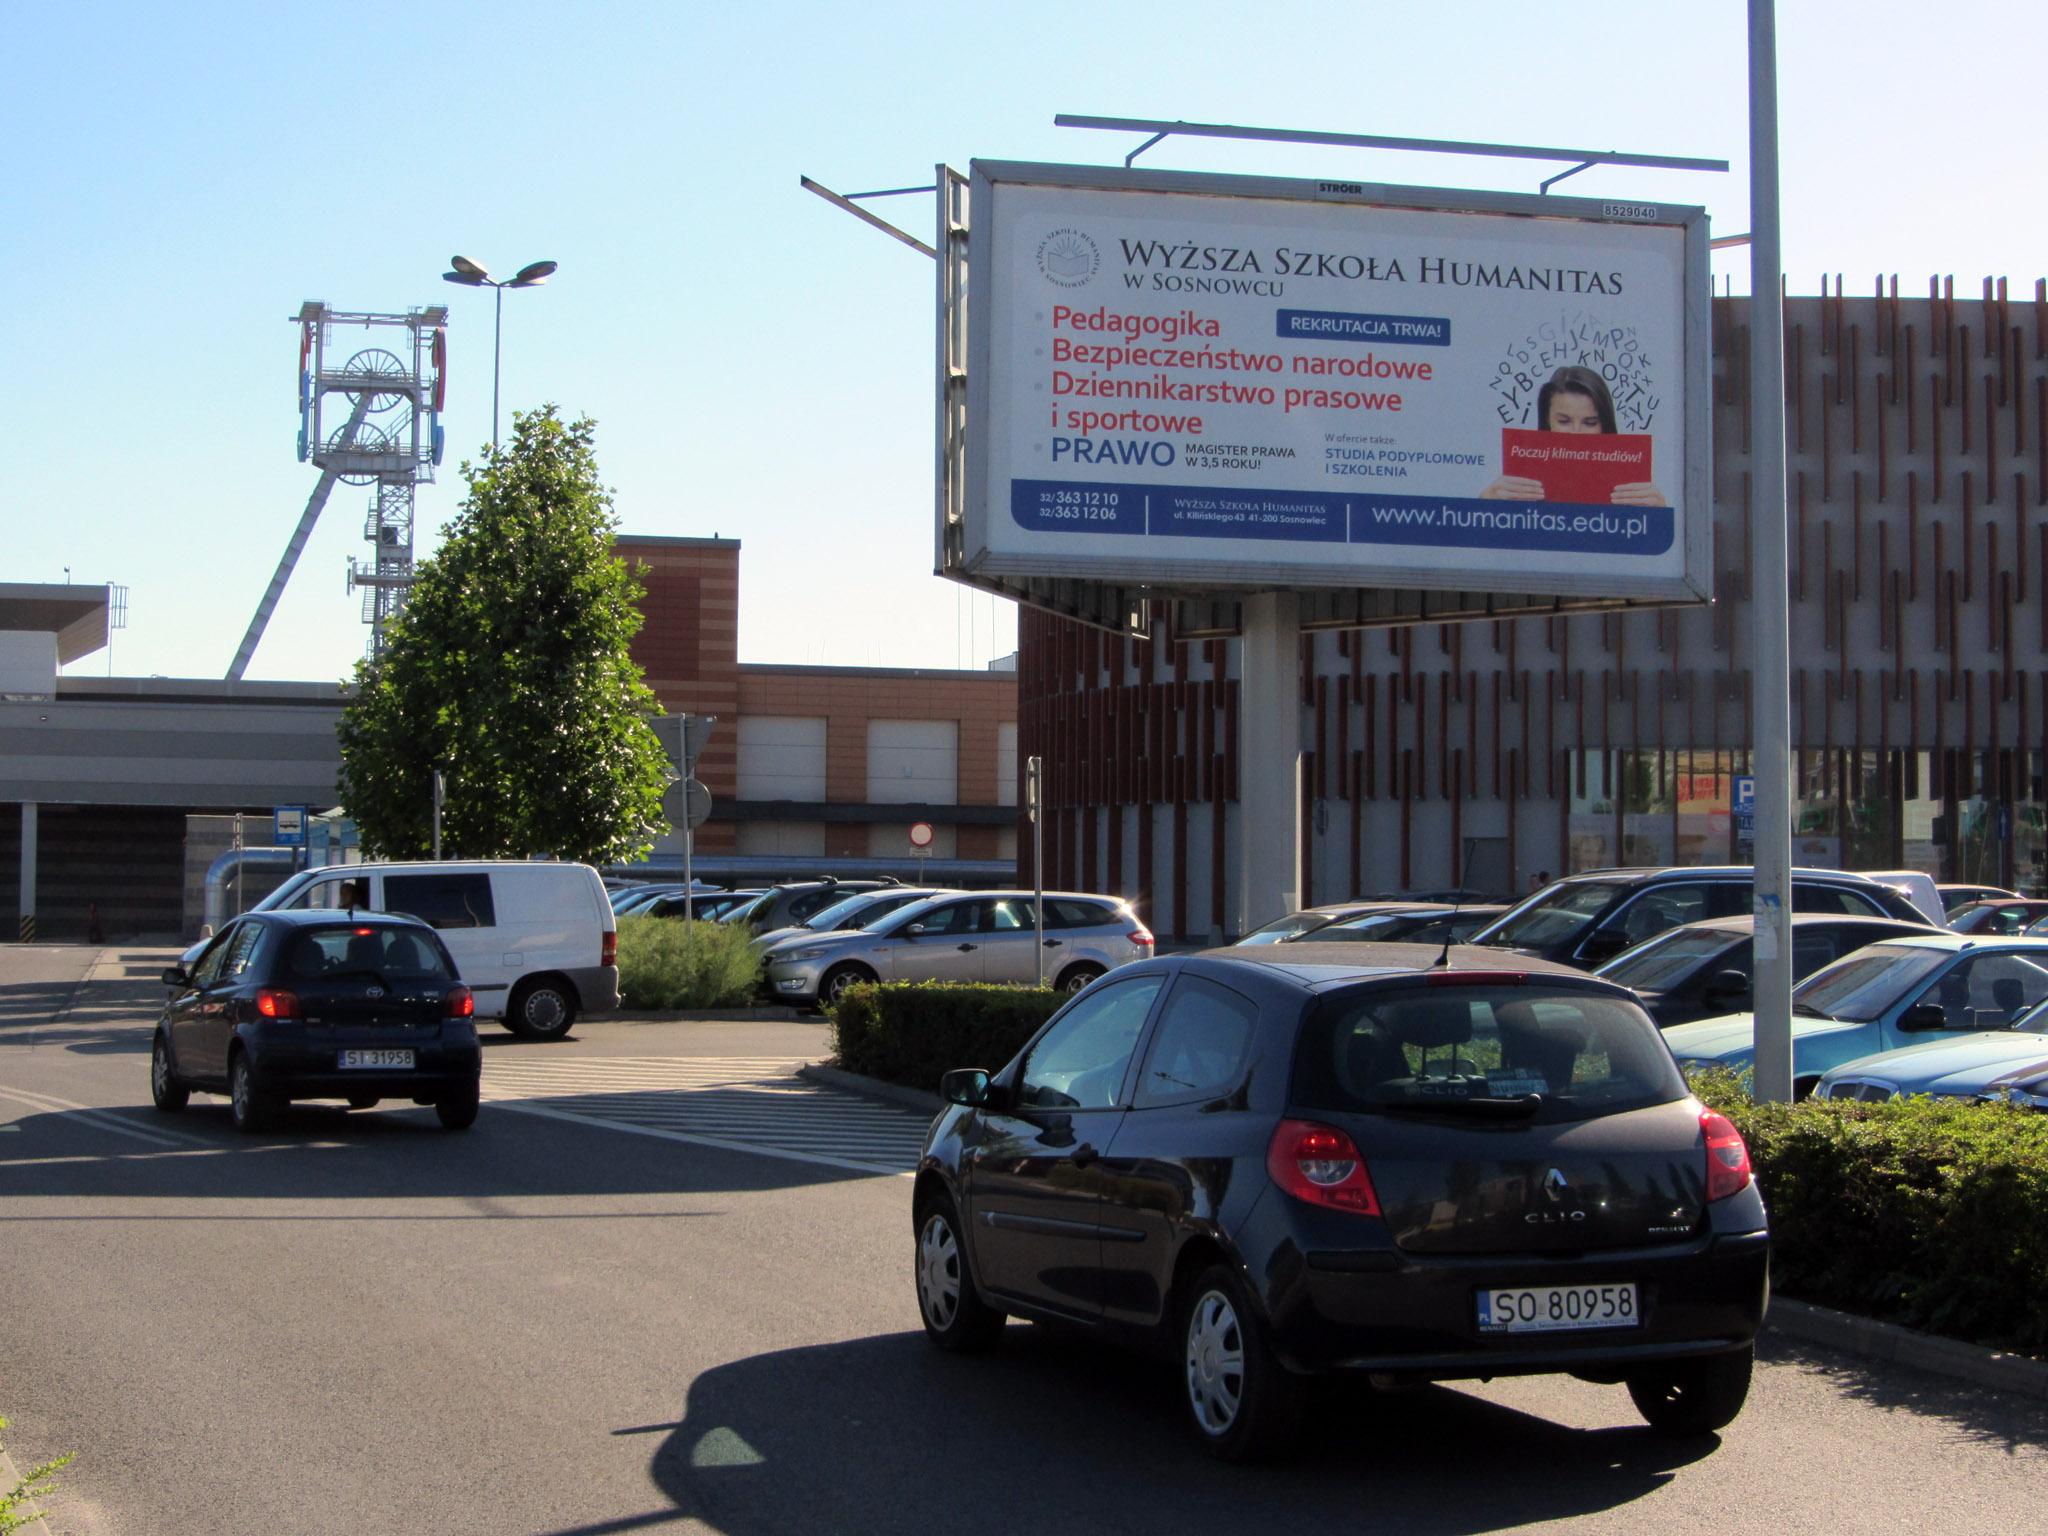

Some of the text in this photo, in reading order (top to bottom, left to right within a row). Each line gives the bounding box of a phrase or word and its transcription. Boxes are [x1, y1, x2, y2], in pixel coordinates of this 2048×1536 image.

[1605, 205, 1655, 218] 8529040
[1119, 238, 1623, 295] WYŻSZA SZKOŁA HUMANITAS
[1152, 273, 1284, 297] SOSNOWCU
[1053, 305, 1220, 342] Pedagogika
[1291, 317, 1441, 338] REKRUTACJA TRWA!
[1053, 338, 1432, 381] Bezpieczeństwo narodowe
[1052, 371, 1402, 413] Dziennikarstwo prasowe
[1051, 402, 1202, 436] i sportowe
[1325, 434, 1334, 442] W
[1336, 434, 1368, 444] ofercie
[1052, 437, 1176, 467] PRAWO
[1185, 443, 1296, 458] MAGISTER PRAWA
[1325, 448, 1485, 466] STUDIA PODYPLOMOWE
[1511, 445, 1642, 462] Poczuj klimat studiów!
[1185, 457, 1261, 470] W 3,5 ROKU!
[1332, 464, 1408, 477] SZKOLENIA
[1262, 502, 1326, 513] HUMANITAS
[1234, 513, 1245, 522] 43
[1248, 514, 1278, 523] 41-200
[1280, 515, 1327, 525] Sosnowiec
[1371, 505, 1647, 538] www.humanitas.edu.pl
[1739, 780, 1754, 803] P
[371, 1051, 412, 1065] 31958
[1525, 1210, 1586, 1223] CLIO
[1496, 1287, 1633, 1323] SO 80958
